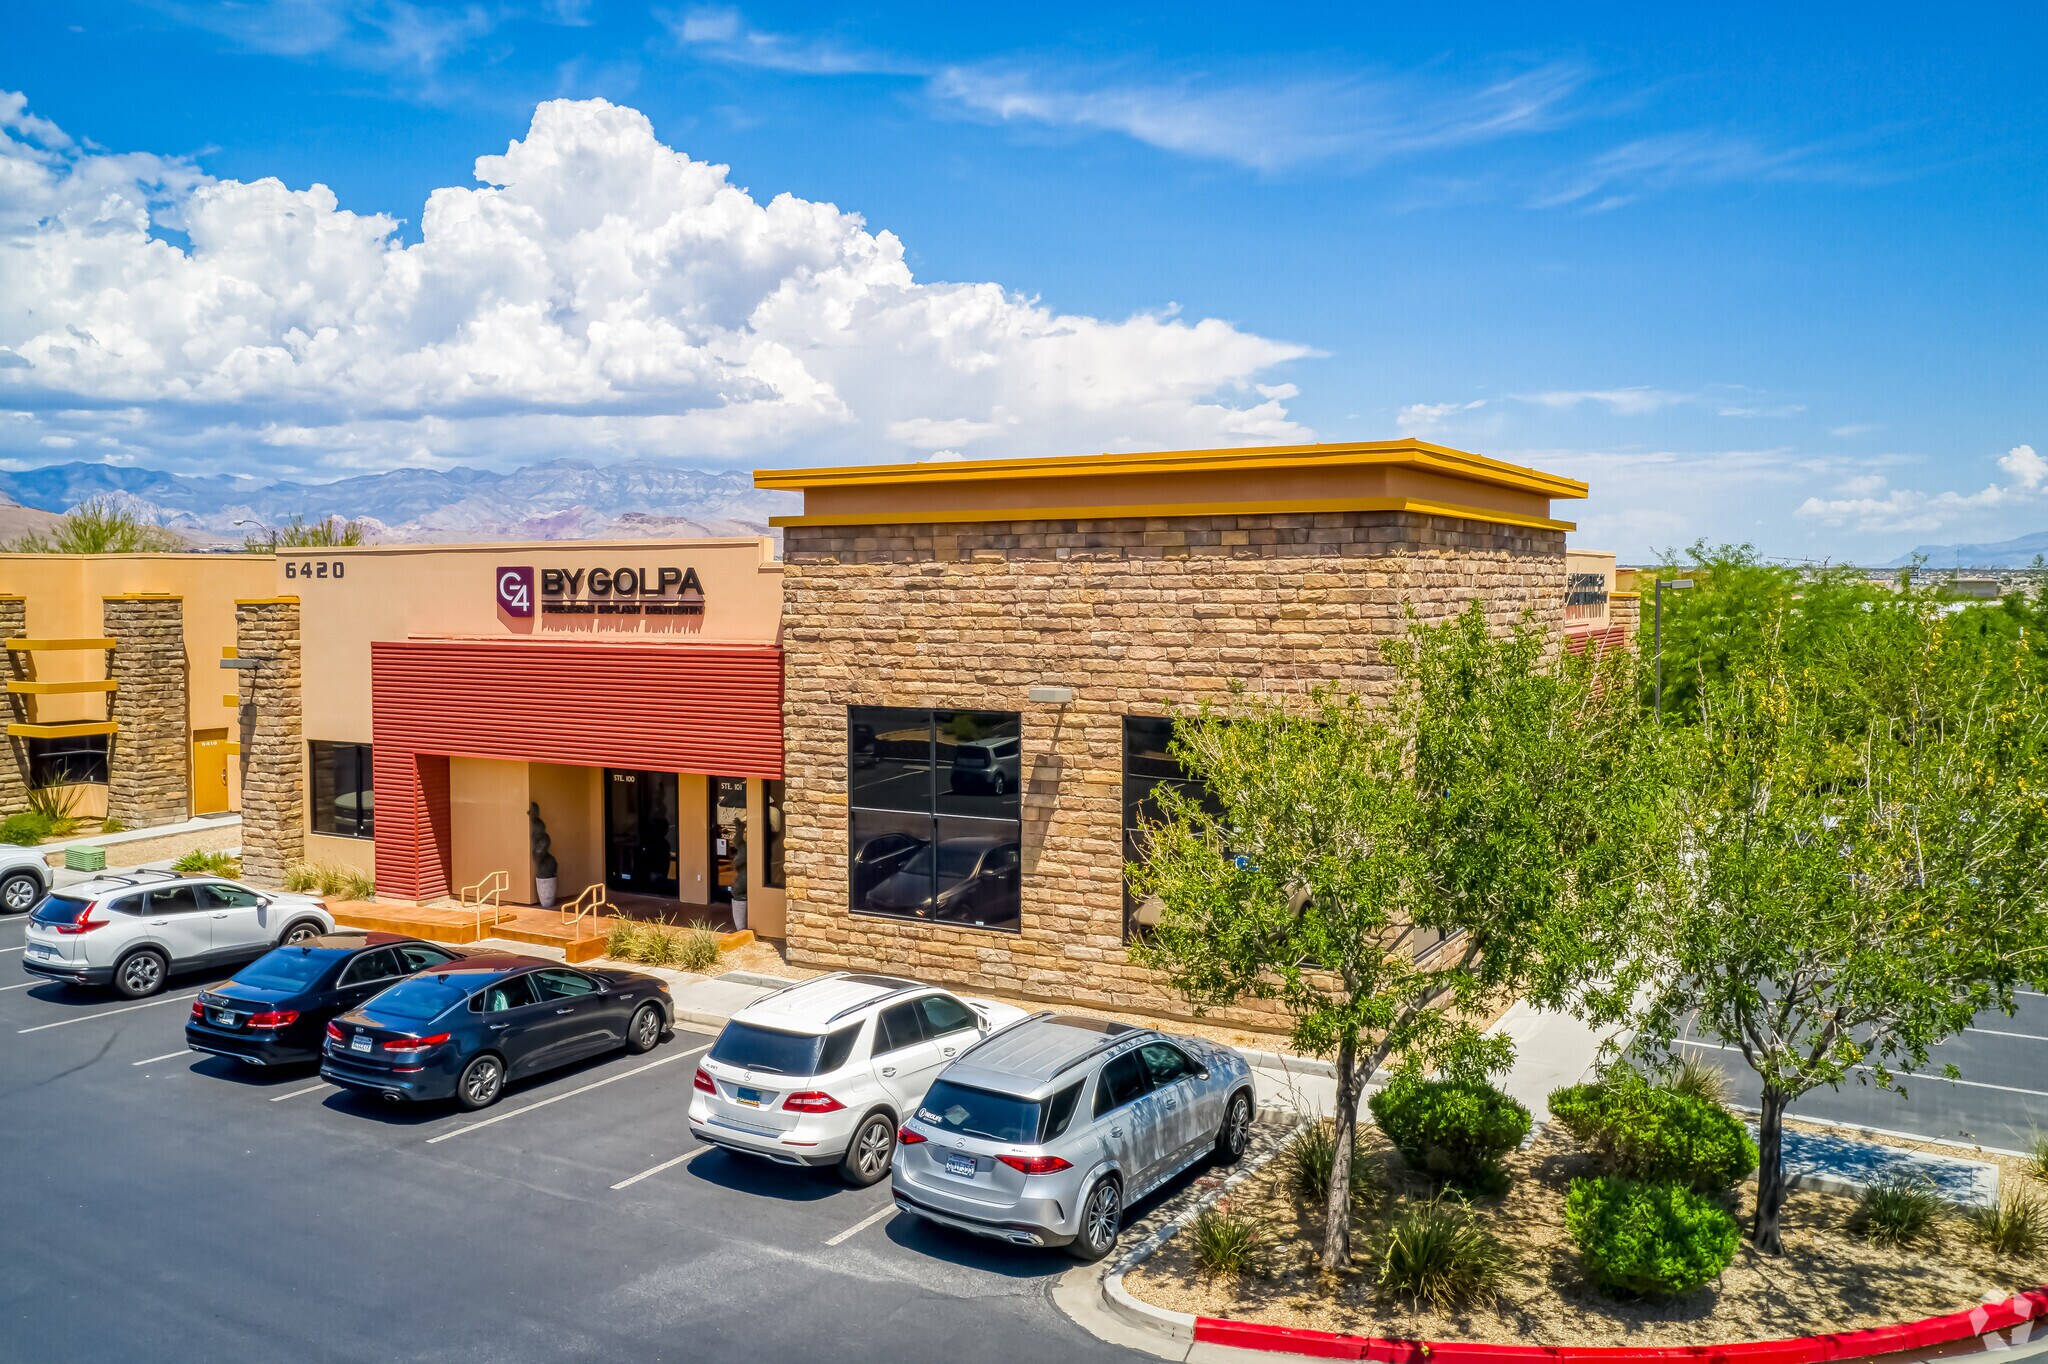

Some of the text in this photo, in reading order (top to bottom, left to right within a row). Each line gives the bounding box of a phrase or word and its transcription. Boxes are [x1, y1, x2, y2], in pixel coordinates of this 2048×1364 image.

[285, 561, 345, 579] 6420
[541, 567, 705, 596] BY GOLPA
[499, 571, 530, 612] G4
[613, 774, 635, 783] STE. 100
[721, 782, 743, 791] STE. 101
